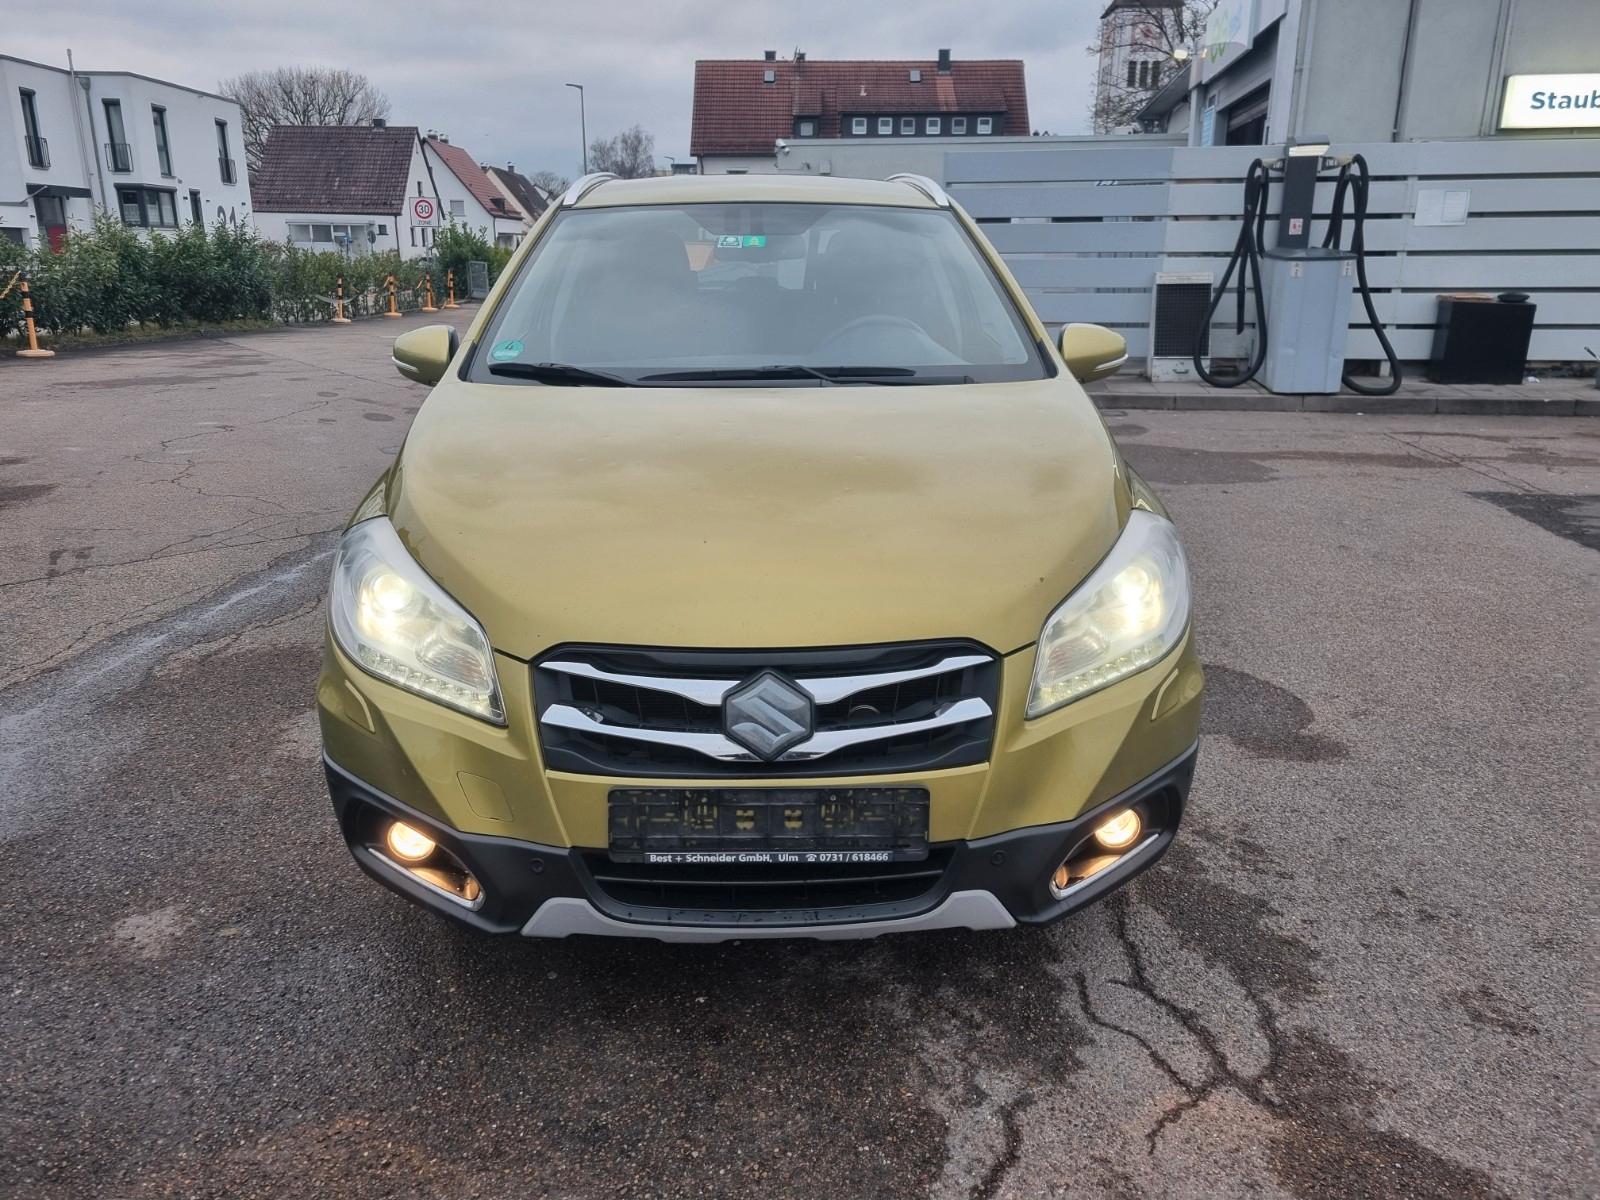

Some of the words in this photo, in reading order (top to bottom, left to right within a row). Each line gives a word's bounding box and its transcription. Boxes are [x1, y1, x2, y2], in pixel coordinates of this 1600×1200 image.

[1530, 90, 1600, 110] Staub
[419, 205, 429, 214] 30
[650, 854, 672, 863] Best
[685, 853, 736, 863] Schneider
[739, 853, 772, 863] GmbH,
[778, 852, 799, 862] Ulm
[820, 853, 843, 862] 0731
[852, 853, 889, 862] 618466
